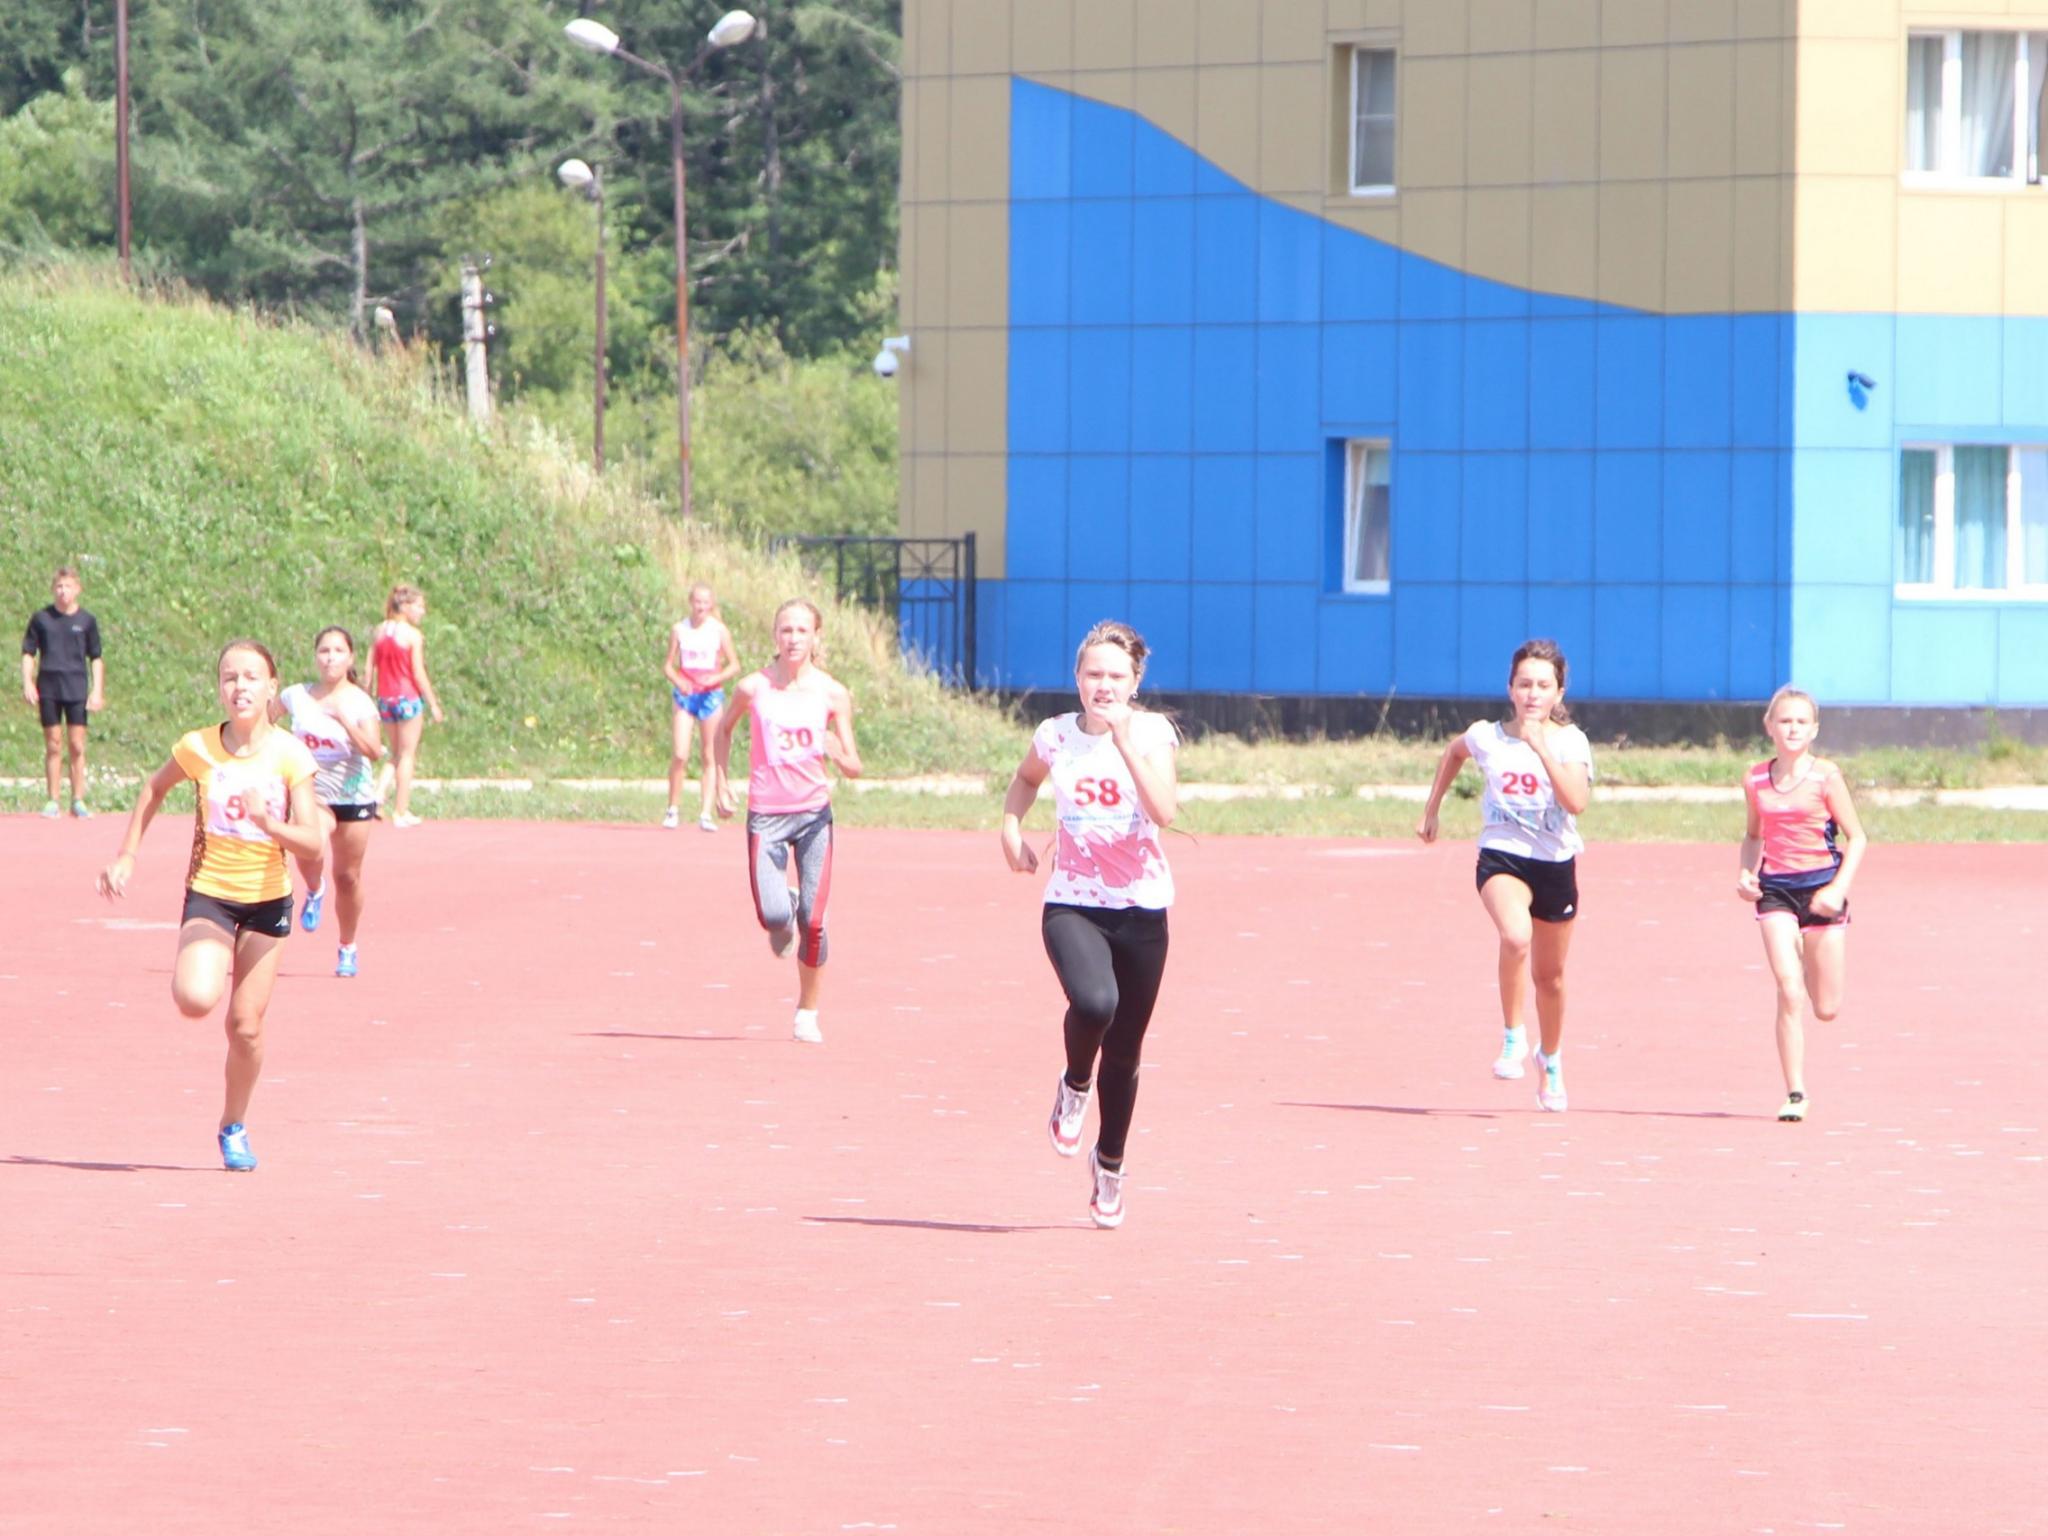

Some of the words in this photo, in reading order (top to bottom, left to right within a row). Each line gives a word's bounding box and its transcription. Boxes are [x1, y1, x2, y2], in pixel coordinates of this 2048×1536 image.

[778, 727, 813, 751] 30
[1074, 777, 1121, 807] 58
[1502, 771, 1538, 795] 29
